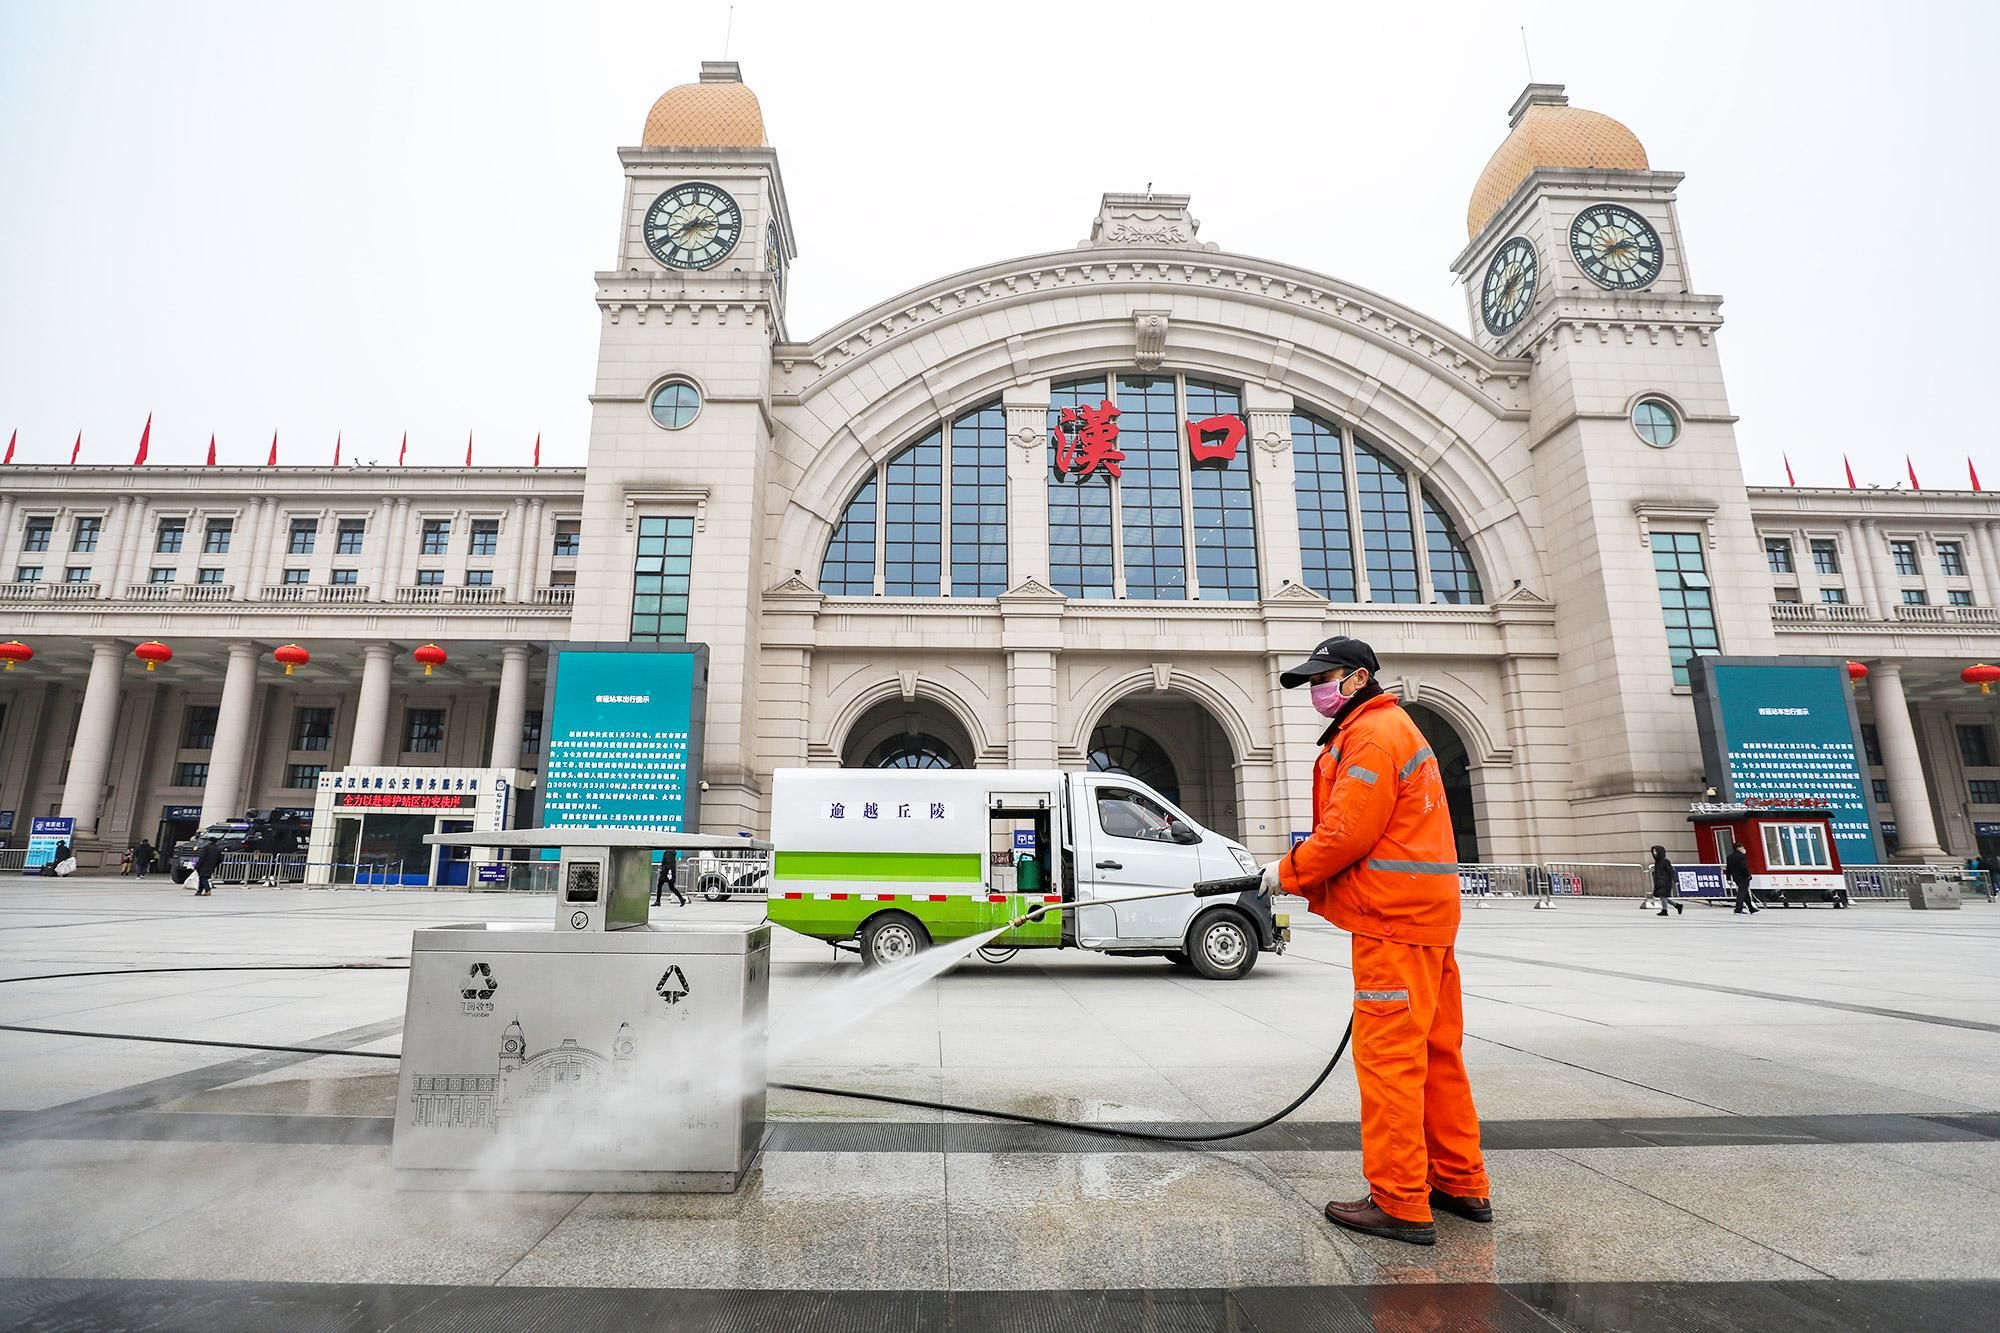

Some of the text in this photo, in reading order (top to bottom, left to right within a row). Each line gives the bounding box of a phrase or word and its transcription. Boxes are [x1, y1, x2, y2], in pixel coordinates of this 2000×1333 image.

[334, 777, 478, 791] 武汉铁路公安警务服务岗
[828, 801, 945, 819] 逾越丘陵
